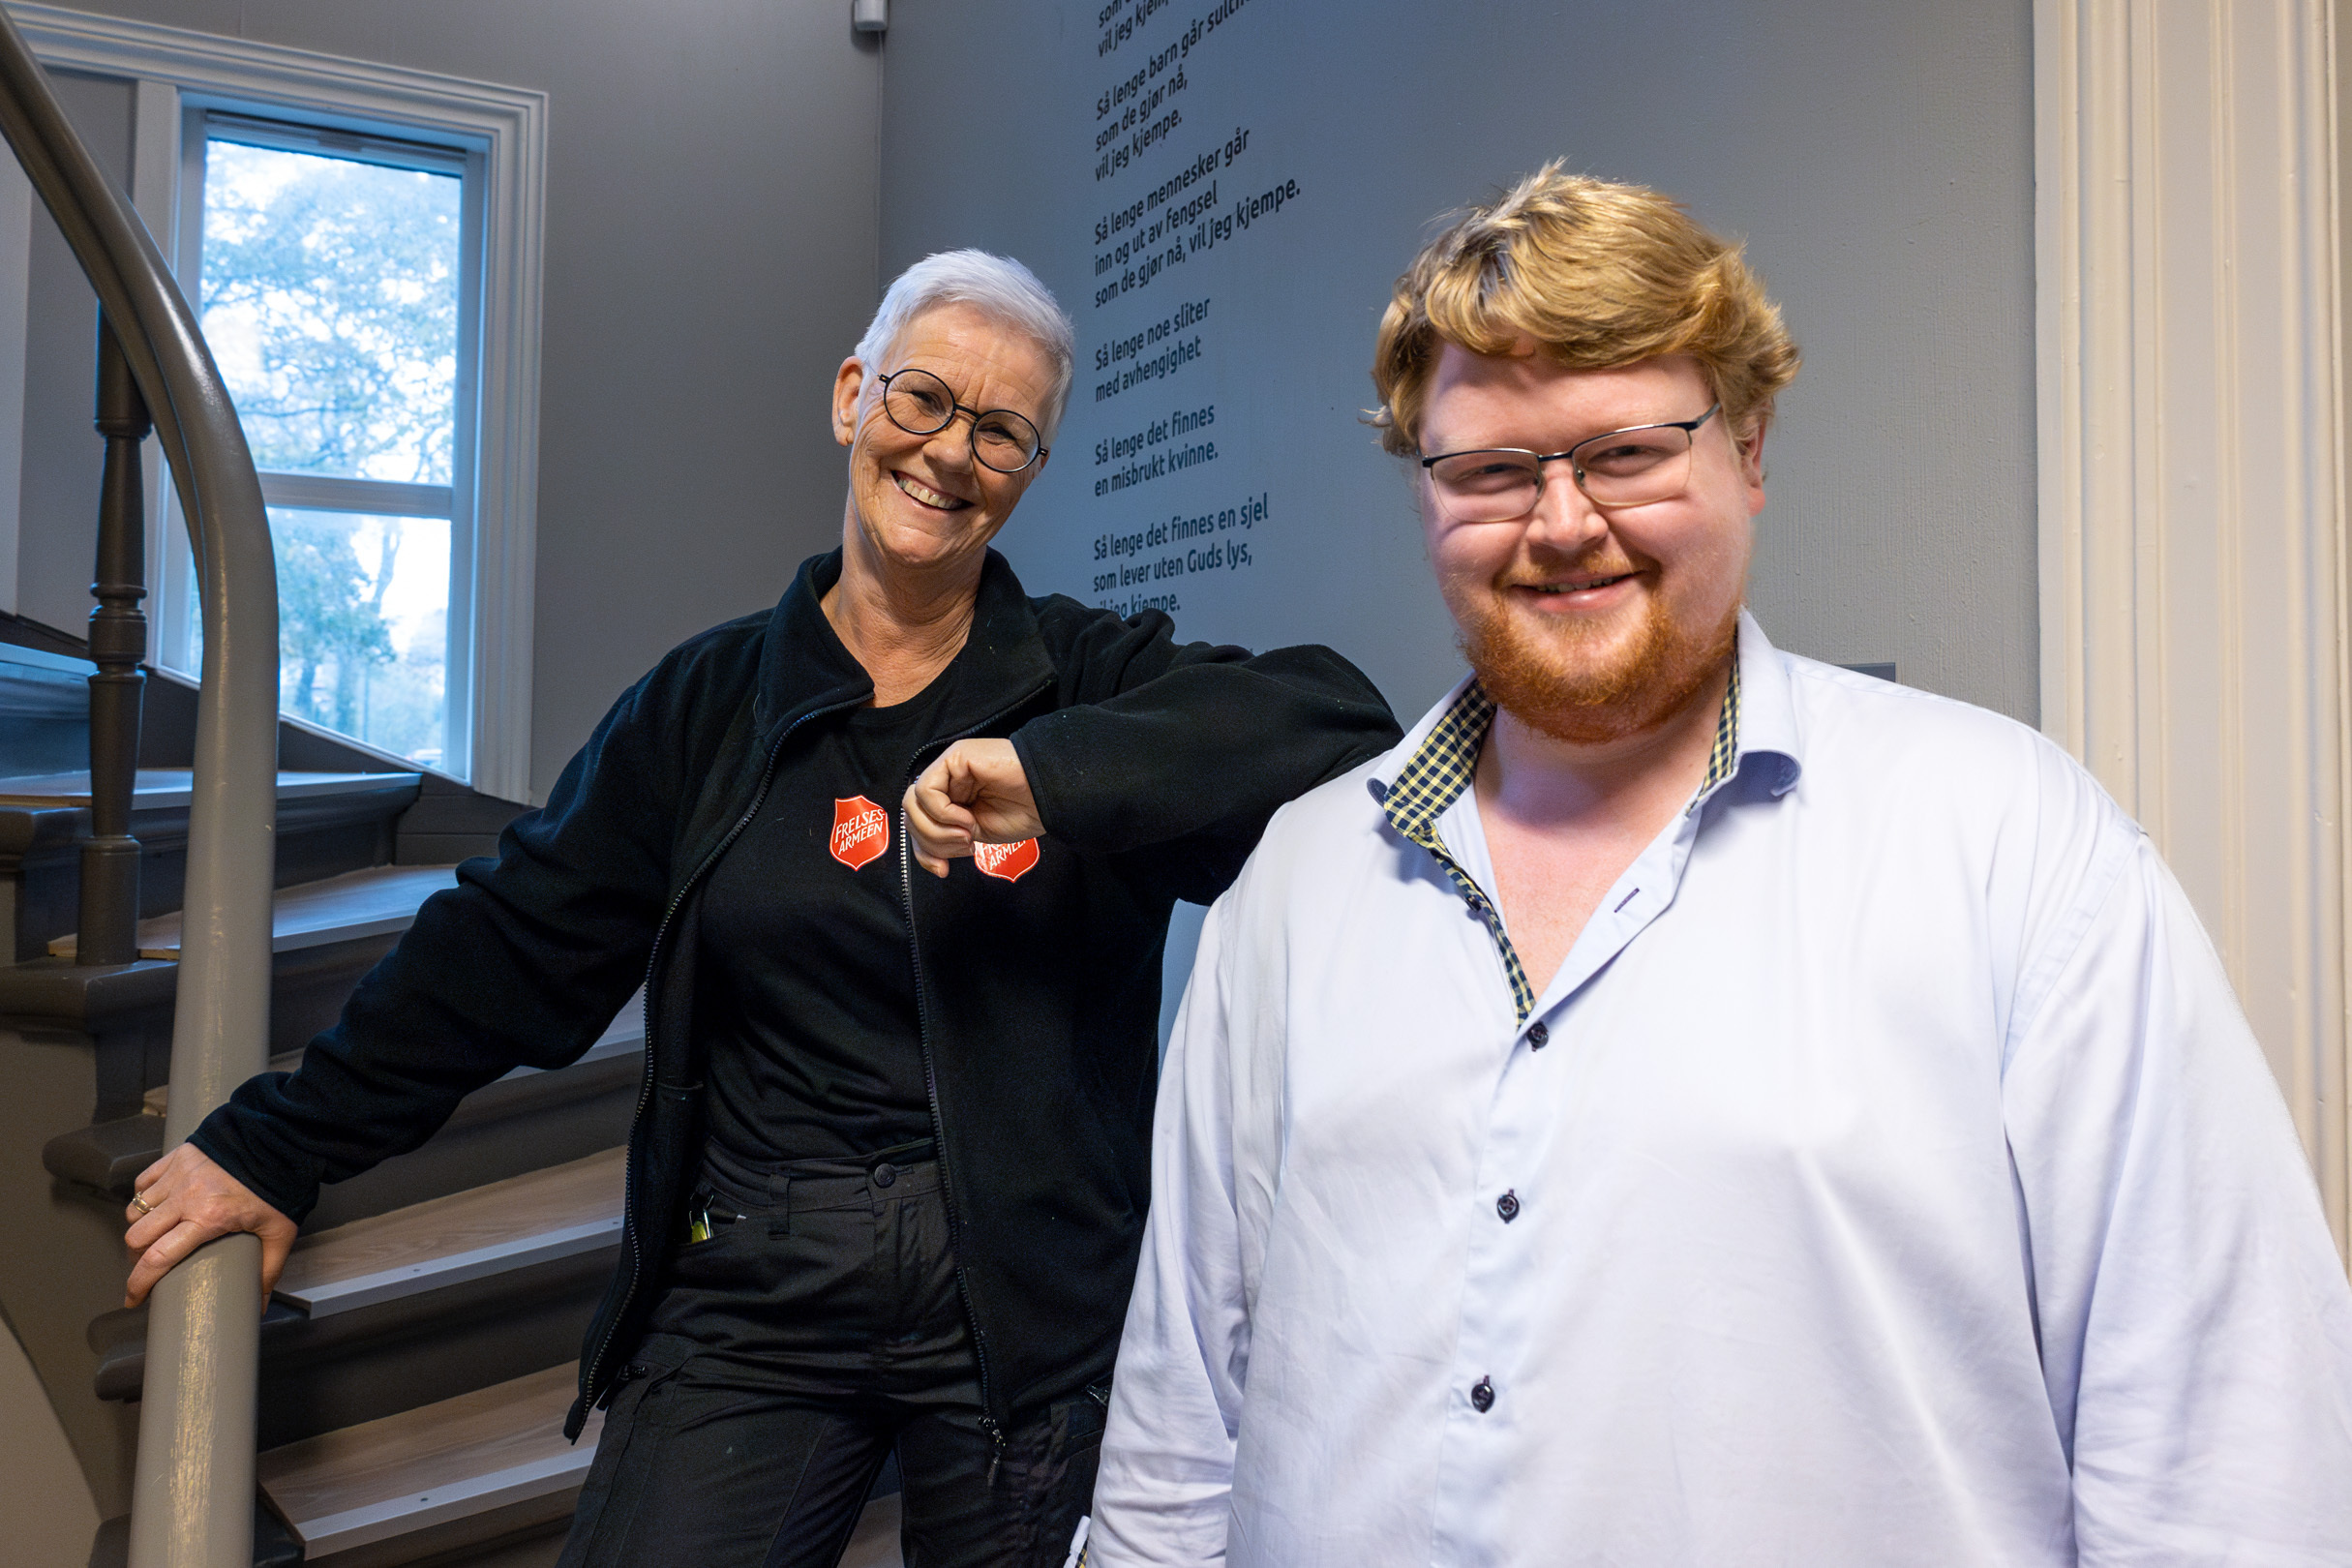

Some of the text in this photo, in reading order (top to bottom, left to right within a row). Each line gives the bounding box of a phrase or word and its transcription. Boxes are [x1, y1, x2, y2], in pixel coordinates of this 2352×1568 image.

[1099, 0, 1122, 28] som
[1099, 28, 1112, 57] vil
[1113, 16, 1132, 51] jeg
[1097, 91, 1109, 121] Så
[1113, 69, 1146, 106] lenge
[1149, 43, 1177, 78] barn
[1182, 18, 1204, 58] går
[1096, 64, 1188, 152] som de gjør nå,
[1096, 109, 1182, 181] vil jeg kjempe.
[1095, 127, 1250, 245] Så lenge mennesker går
[1095, 180, 1218, 277] inn og ut av fengsel
[1096, 179, 1300, 308] som de gjør nå, vil jeg kjempe.
[1096, 298, 1210, 371] Så lenge noe sliter
[1096, 335, 1201, 403] med avhengighet
[1095, 441, 1219, 497] en misbrukt kvinne.
[1096, 405, 1215, 466] Så lenge det finnes
[1094, 492, 1268, 560] Så lenge det finnes en sjel
[1094, 539, 1251, 592] som lever uten Guds lys,
[835, 809, 885, 844] FRELSES-
[838, 822, 883, 856] ARMEEN
